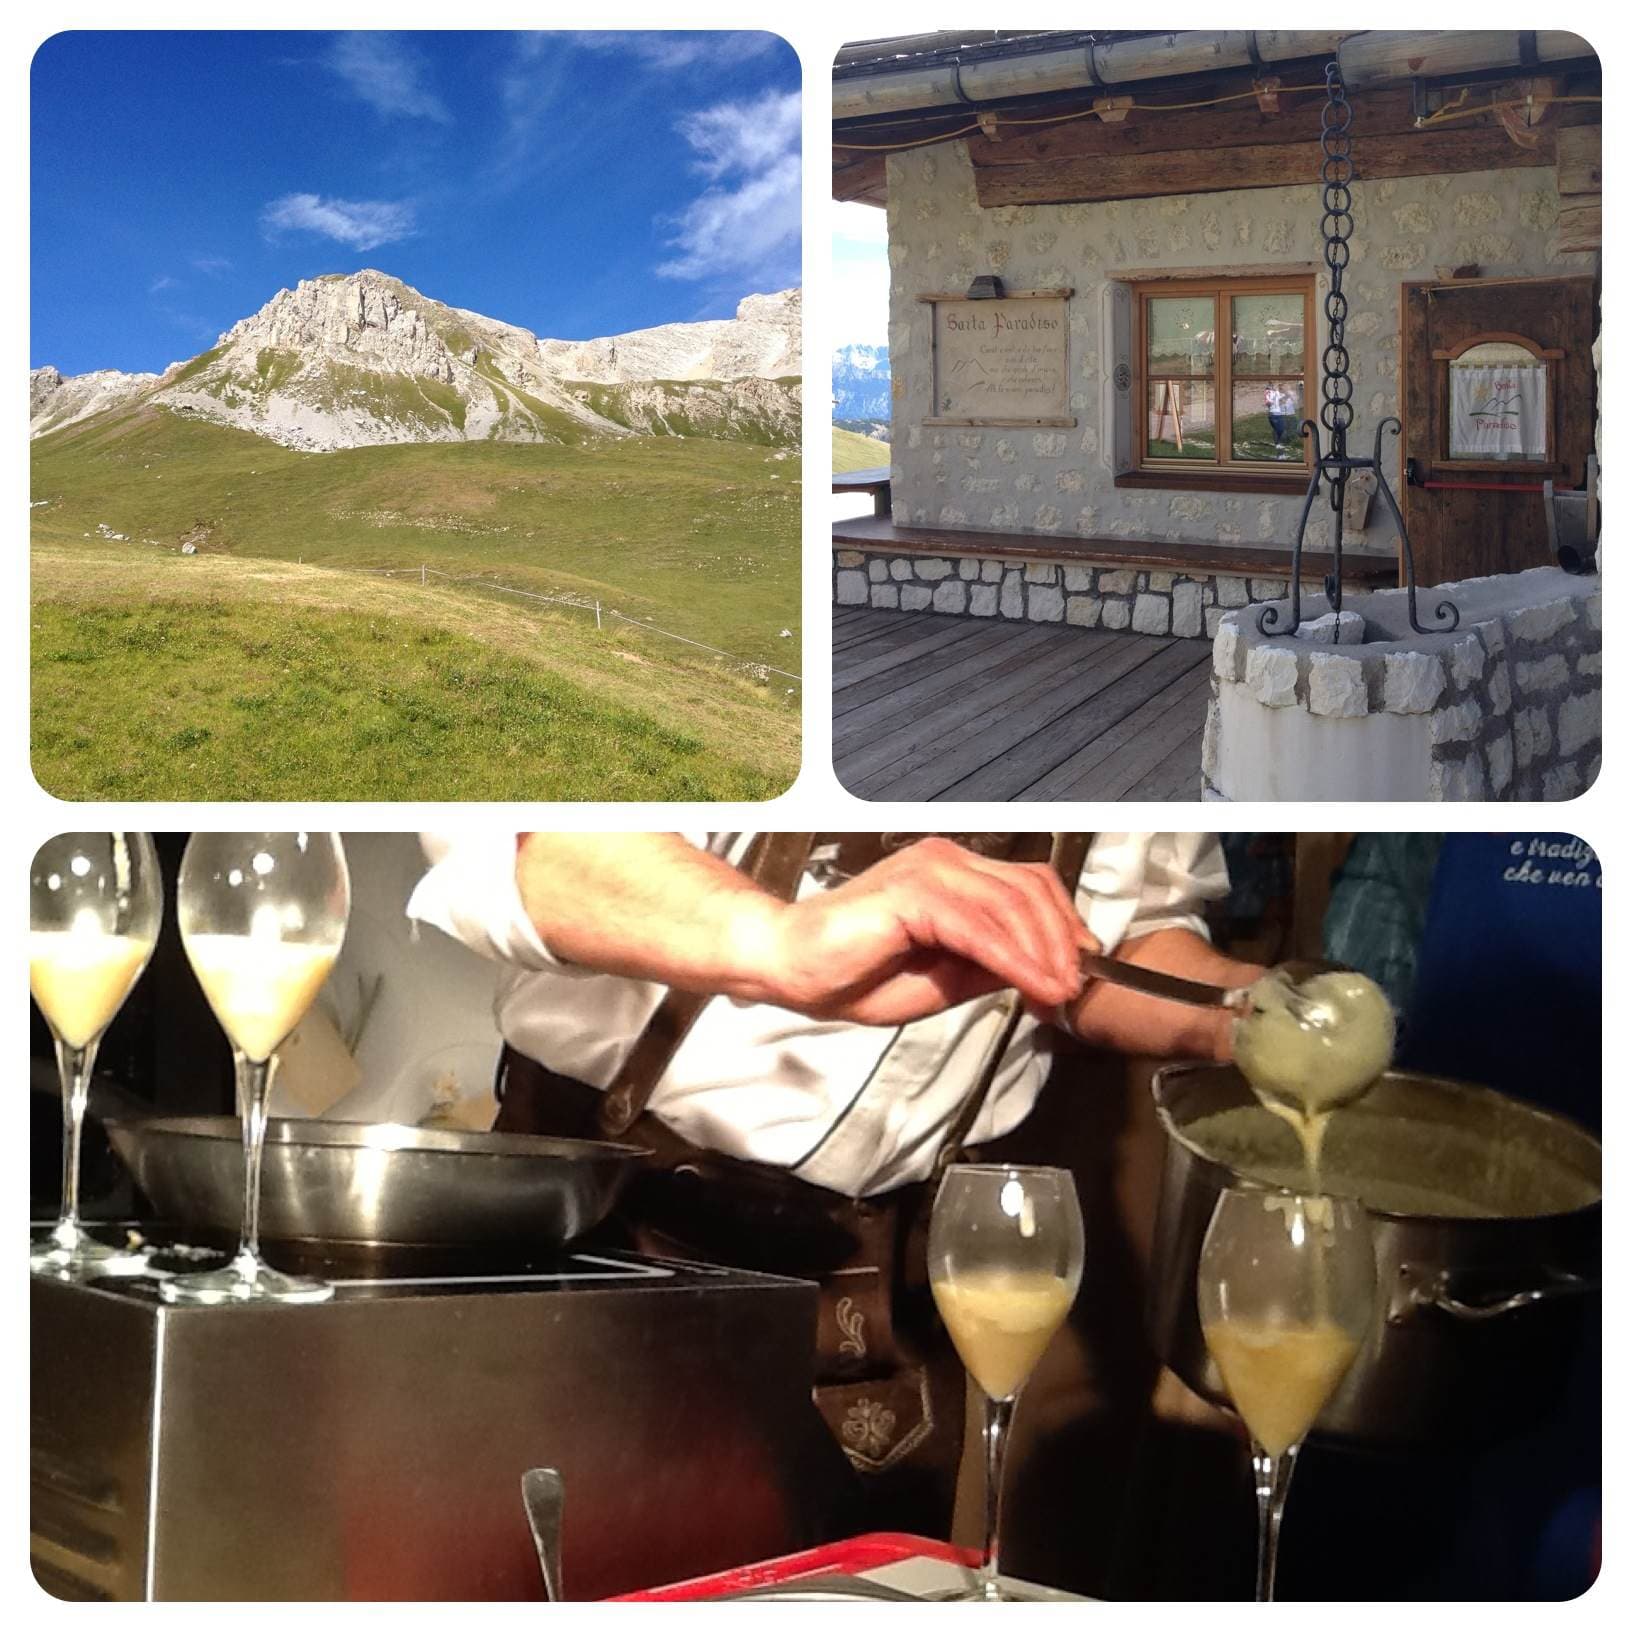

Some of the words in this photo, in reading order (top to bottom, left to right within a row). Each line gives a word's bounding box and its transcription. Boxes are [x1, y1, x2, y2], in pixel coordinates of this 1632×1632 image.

[946, 312, 987, 331] Baita
[992, 311, 1059, 338] Paradiso
[1475, 417, 1518, 431] Paradiso
[1510, 840, 1524, 856] e
[1503, 859, 1545, 884] che
